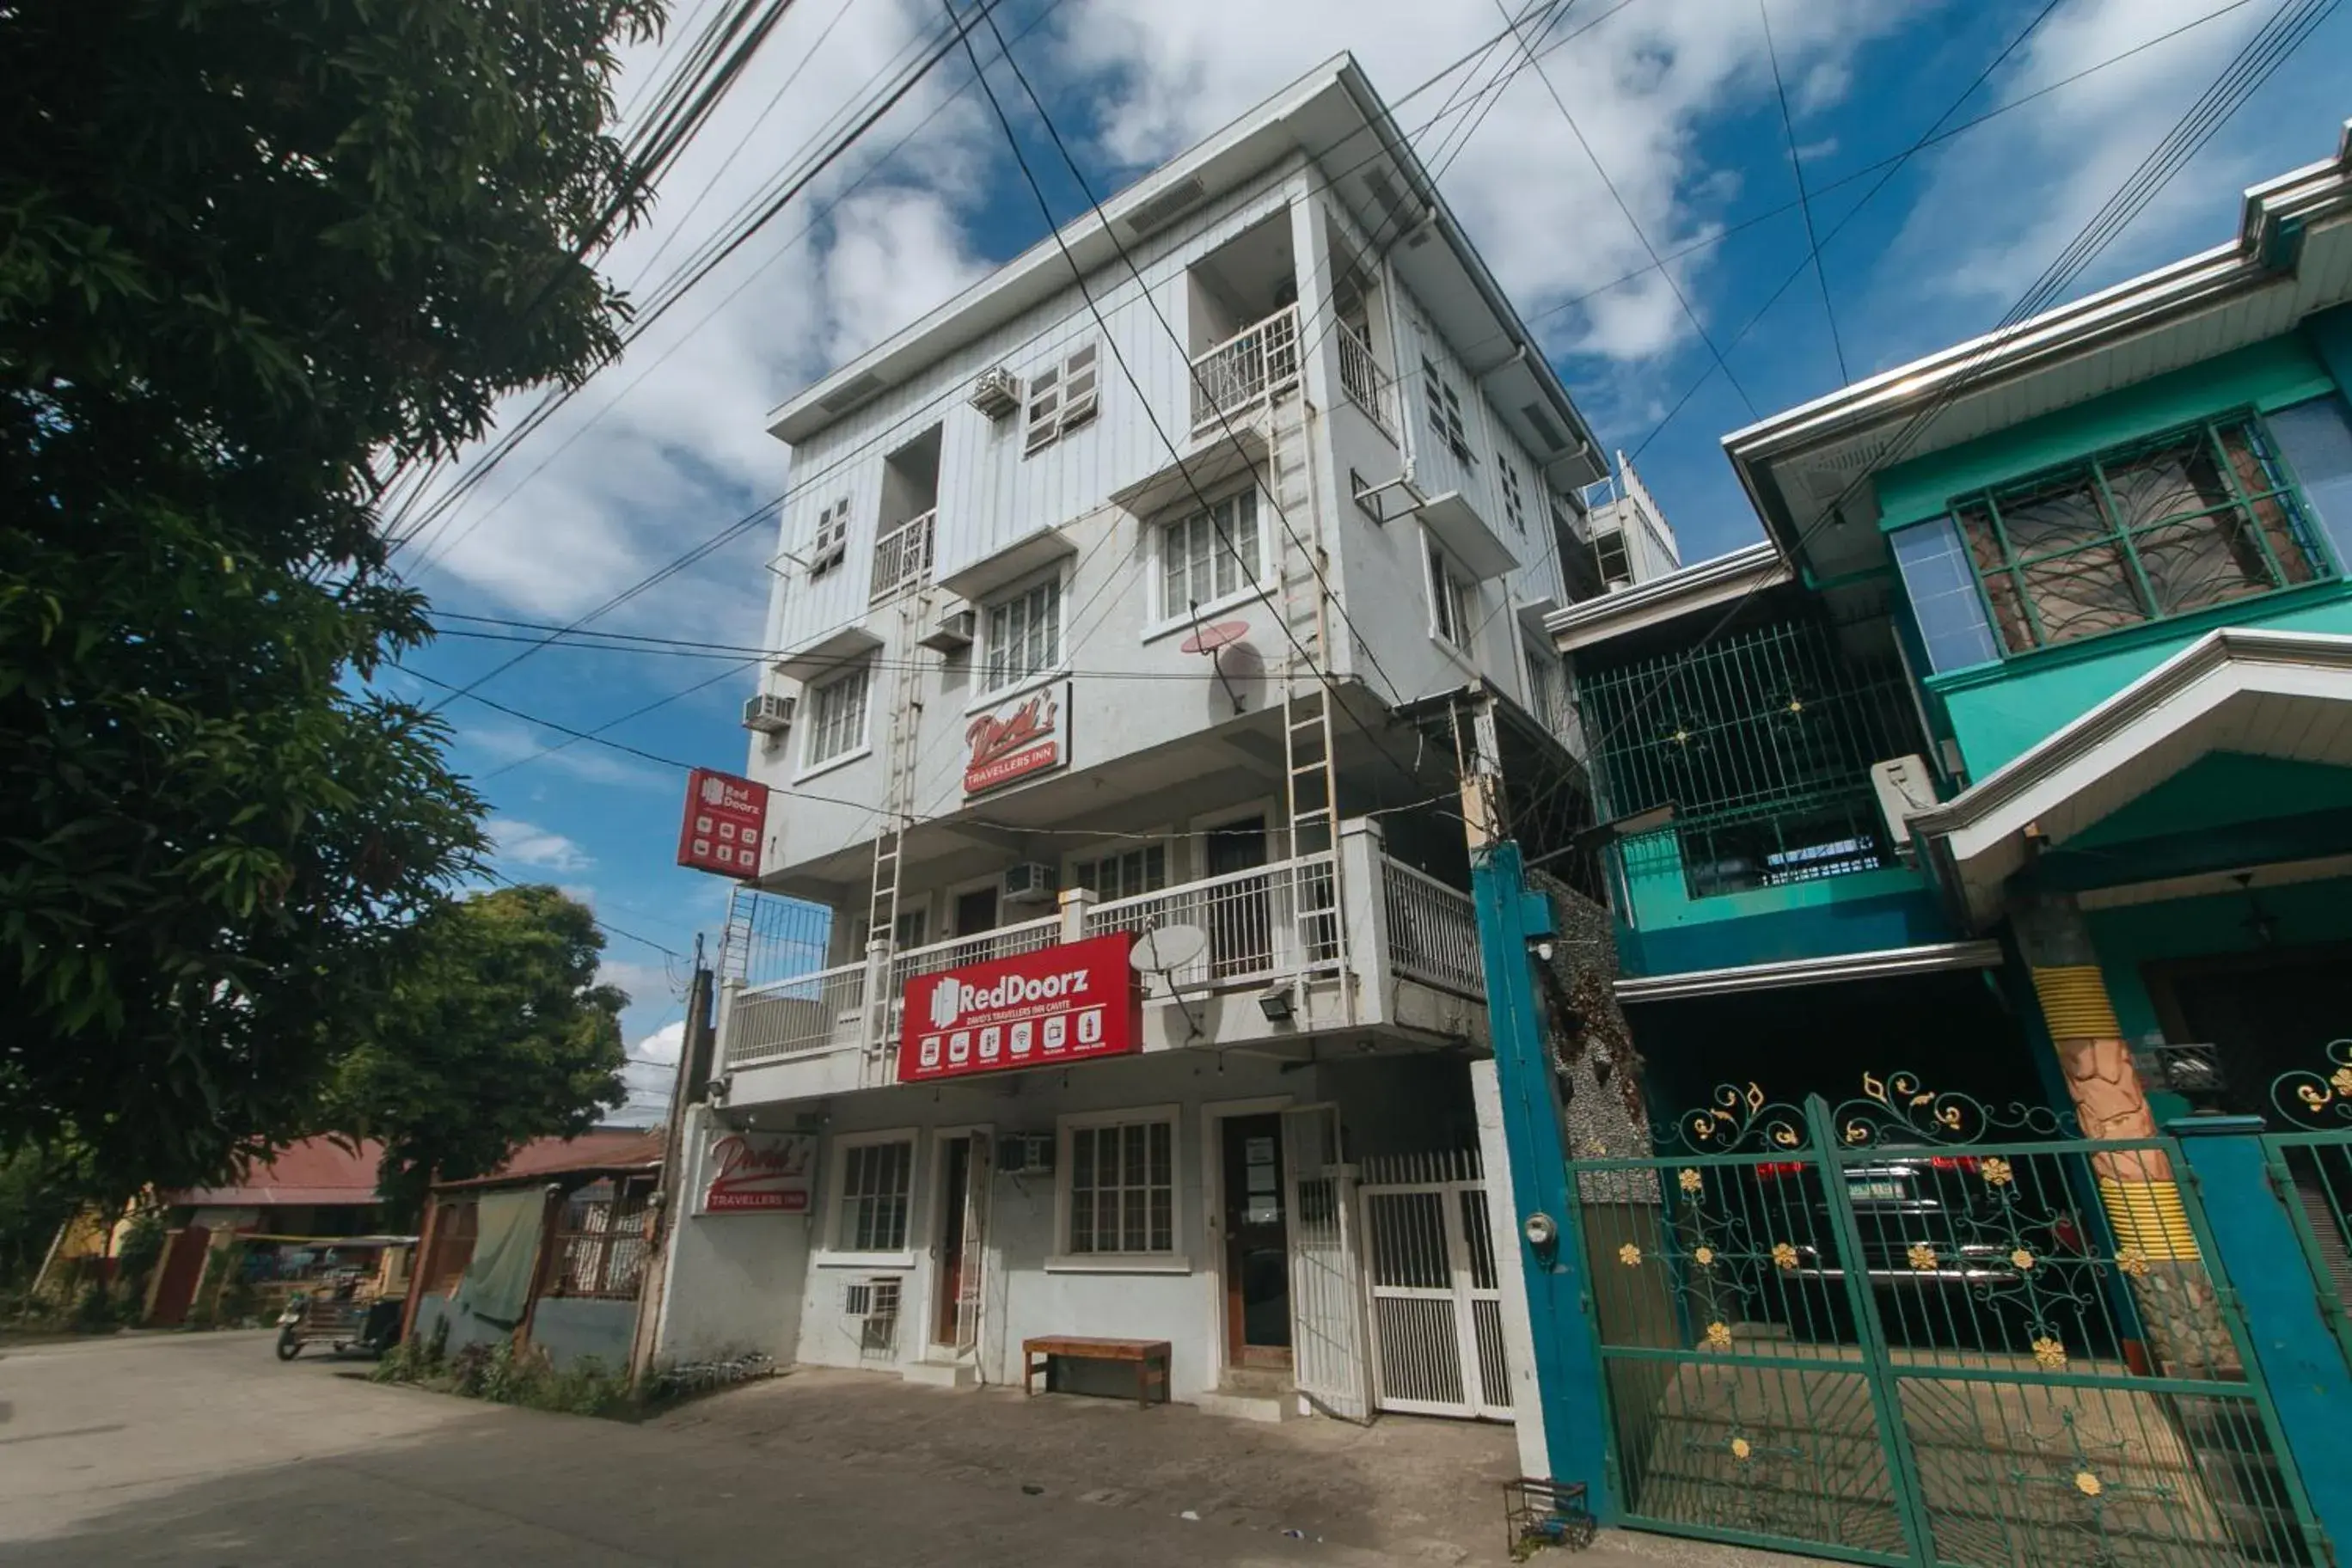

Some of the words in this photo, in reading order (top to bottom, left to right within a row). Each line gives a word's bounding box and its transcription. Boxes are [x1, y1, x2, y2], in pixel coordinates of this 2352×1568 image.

[967, 754, 1030, 785] TRAVELLERS
[1032, 747, 1053, 763] INN
[725, 785, 748, 800] Red
[724, 797, 761, 814] Doorz
[959, 969, 1089, 1014] RedDoorz
[993, 1007, 1032, 1021] TRAVELLERS
[1046, 1000, 1071, 1013] CAVITE
[711, 1194, 782, 1206] TRAVELLERS
[784, 1193, 804, 1205] INN
